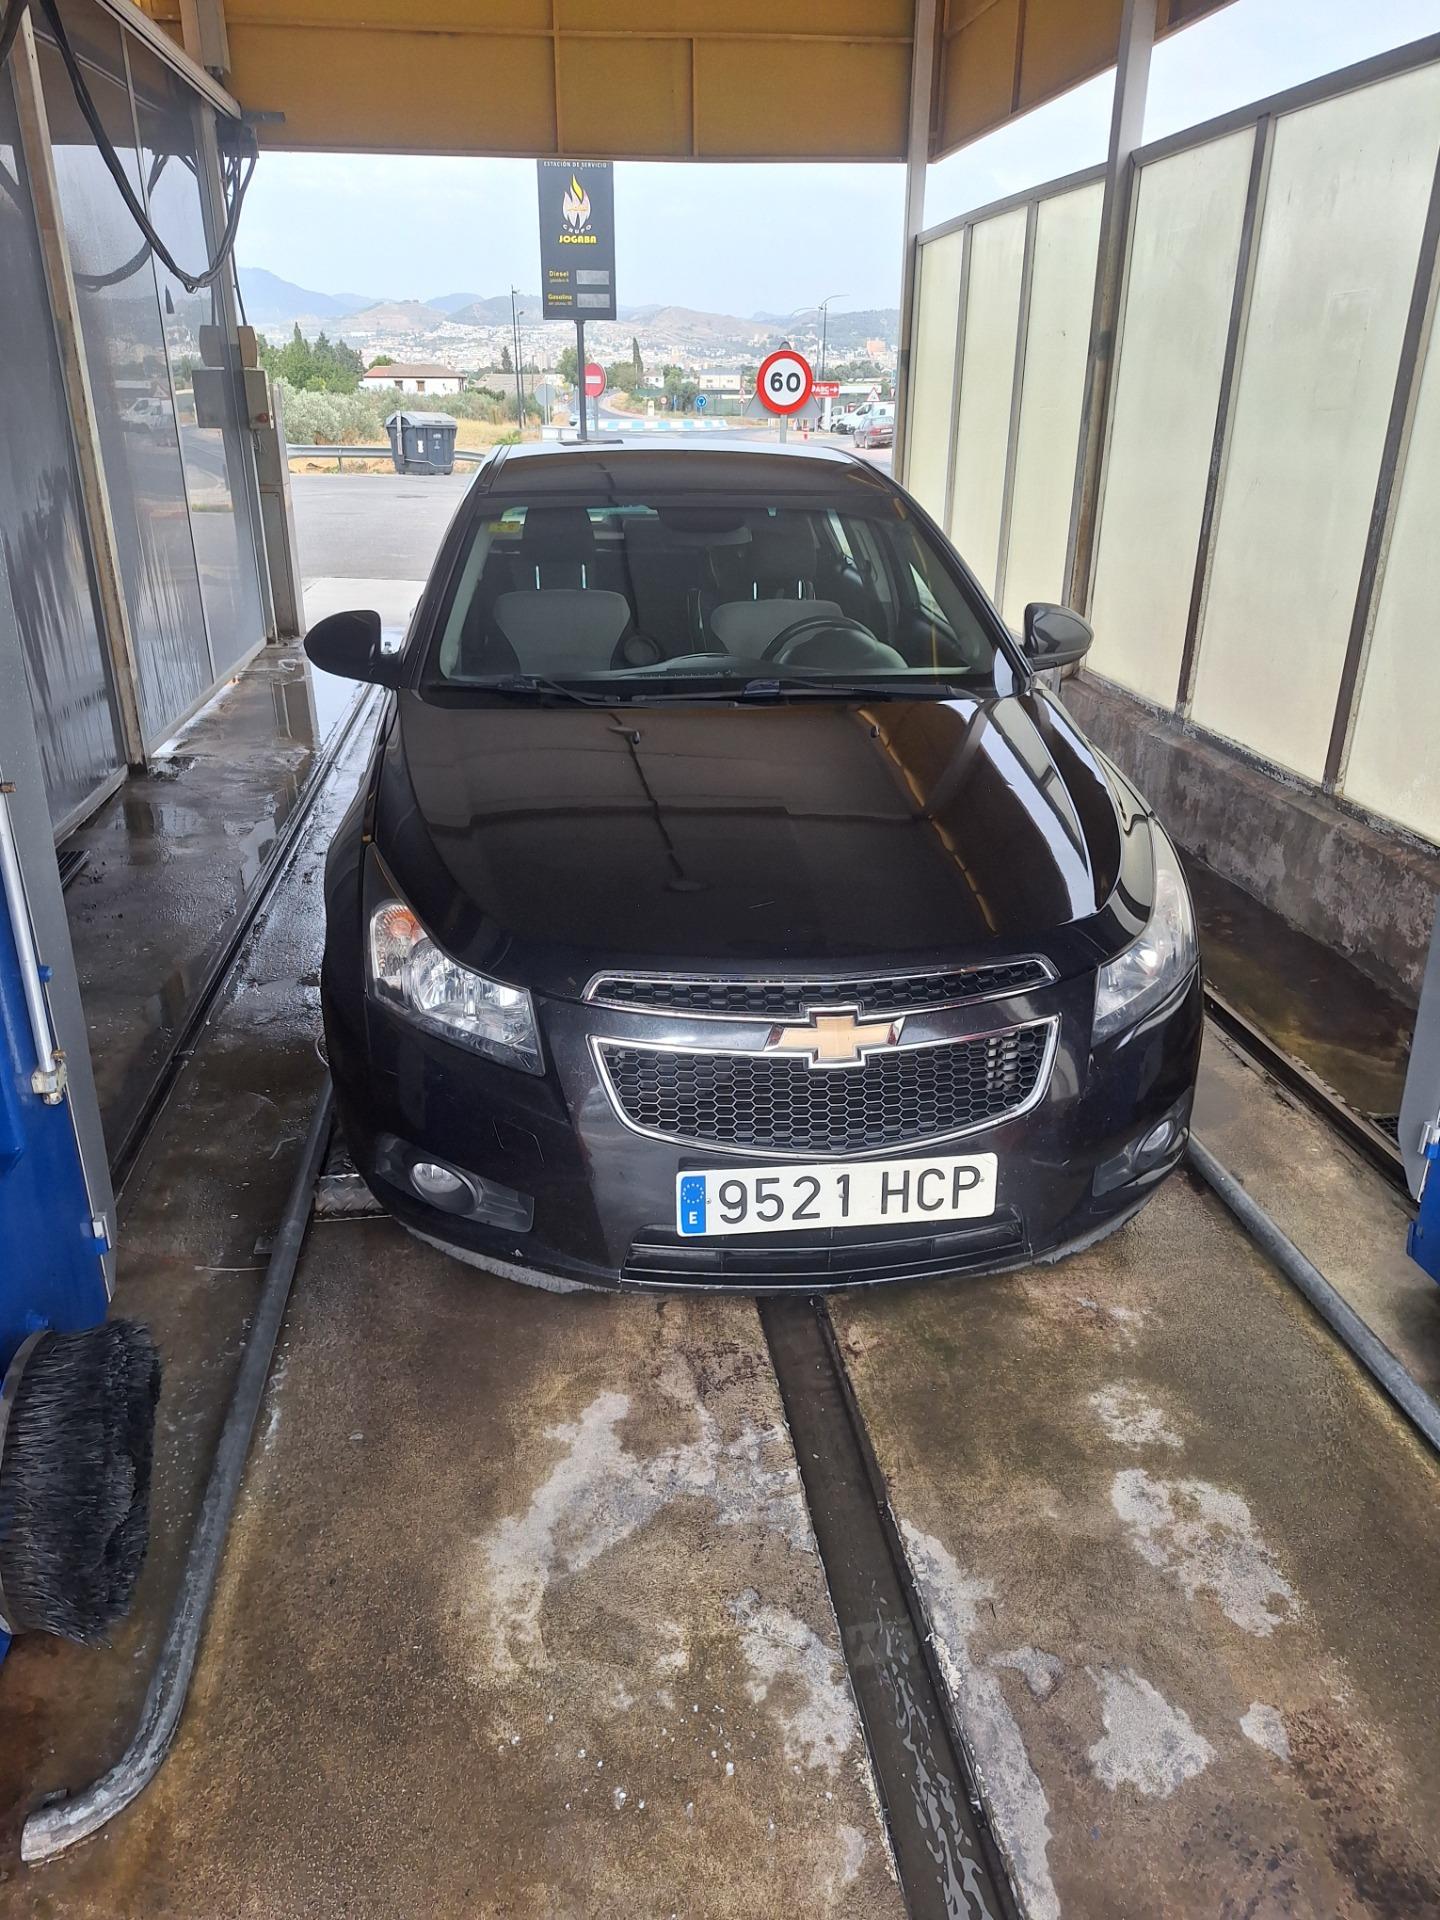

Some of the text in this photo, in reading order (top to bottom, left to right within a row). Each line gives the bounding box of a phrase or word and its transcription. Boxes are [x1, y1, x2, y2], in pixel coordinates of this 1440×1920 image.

[559, 234, 597, 244] JOGABA
[770, 372, 801, 392] 60
[718, 1165, 981, 1225] 9521 HCP
[688, 1211, 698, 1225] E
